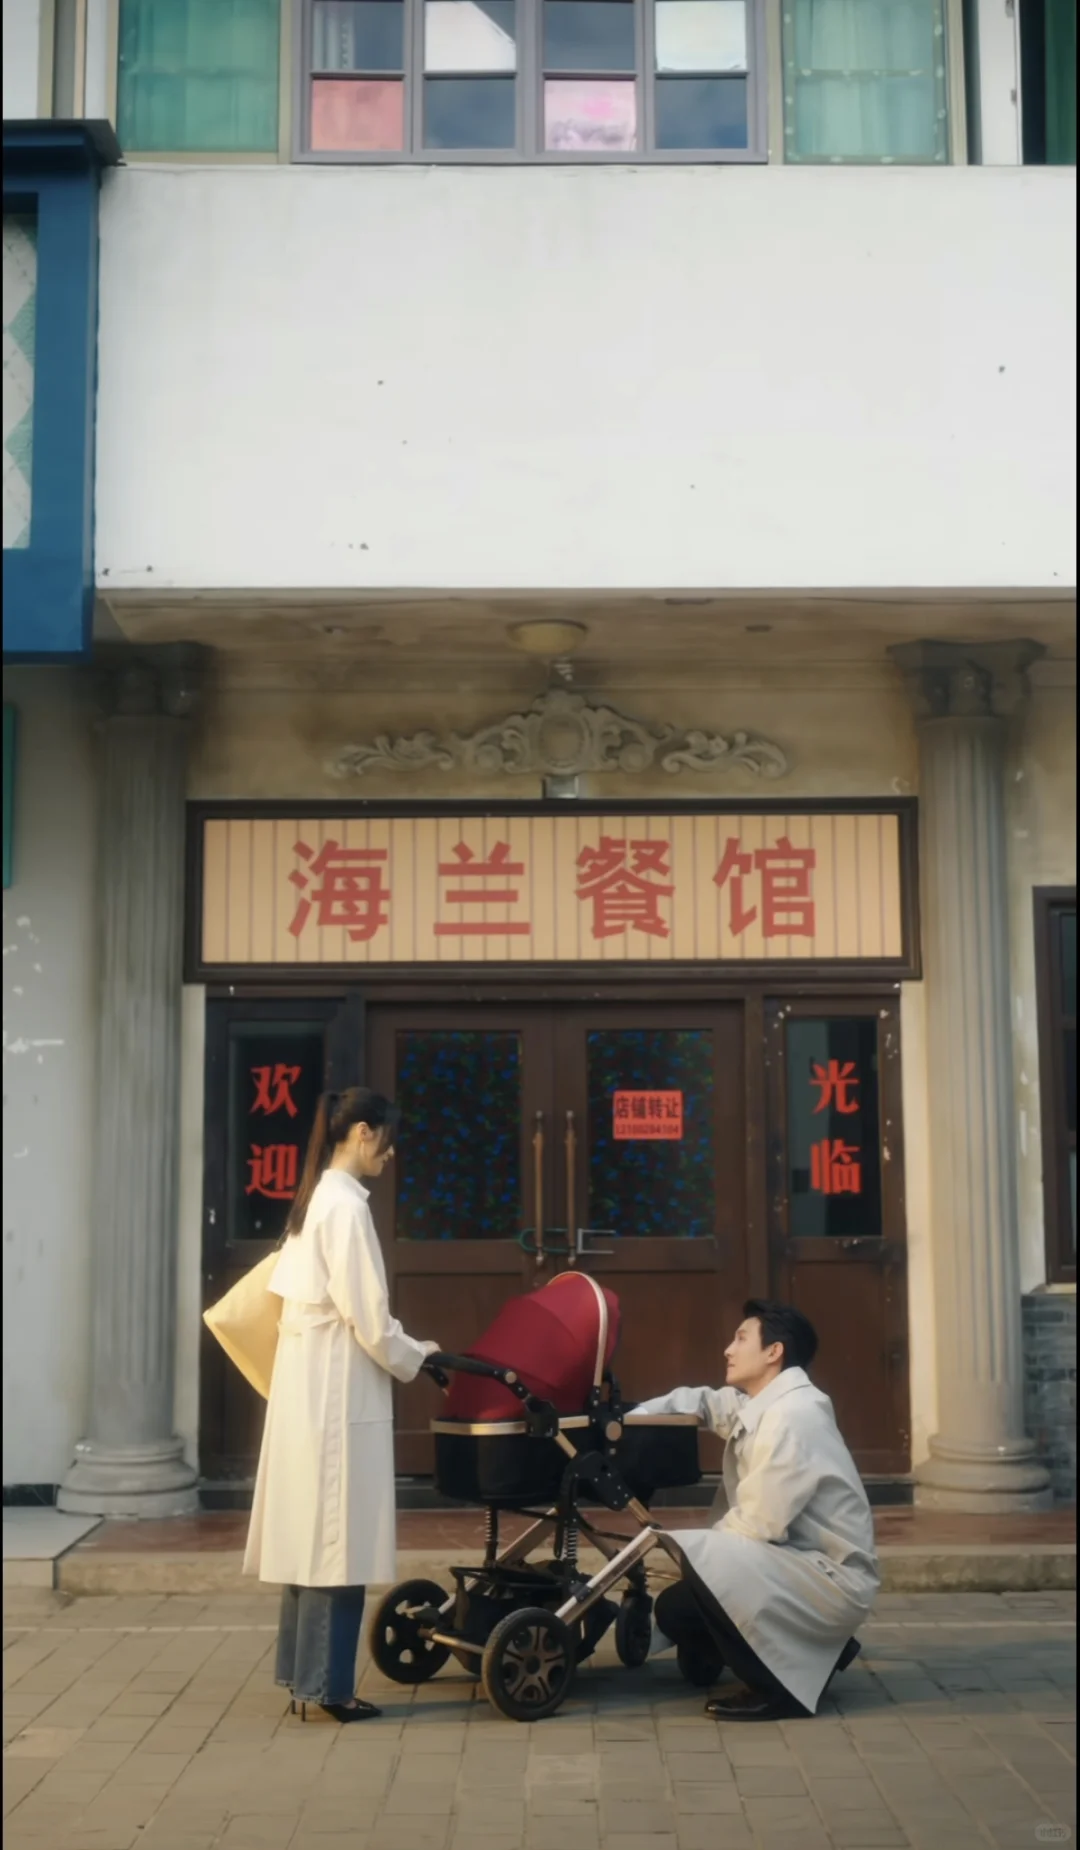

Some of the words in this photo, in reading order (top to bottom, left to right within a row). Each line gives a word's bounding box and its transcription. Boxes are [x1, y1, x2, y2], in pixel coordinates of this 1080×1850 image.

[288, 836, 816, 942] 海兰餐馆
[244, 1063, 302, 1199] 欢迎
[809, 1058, 862, 1195] 光临
